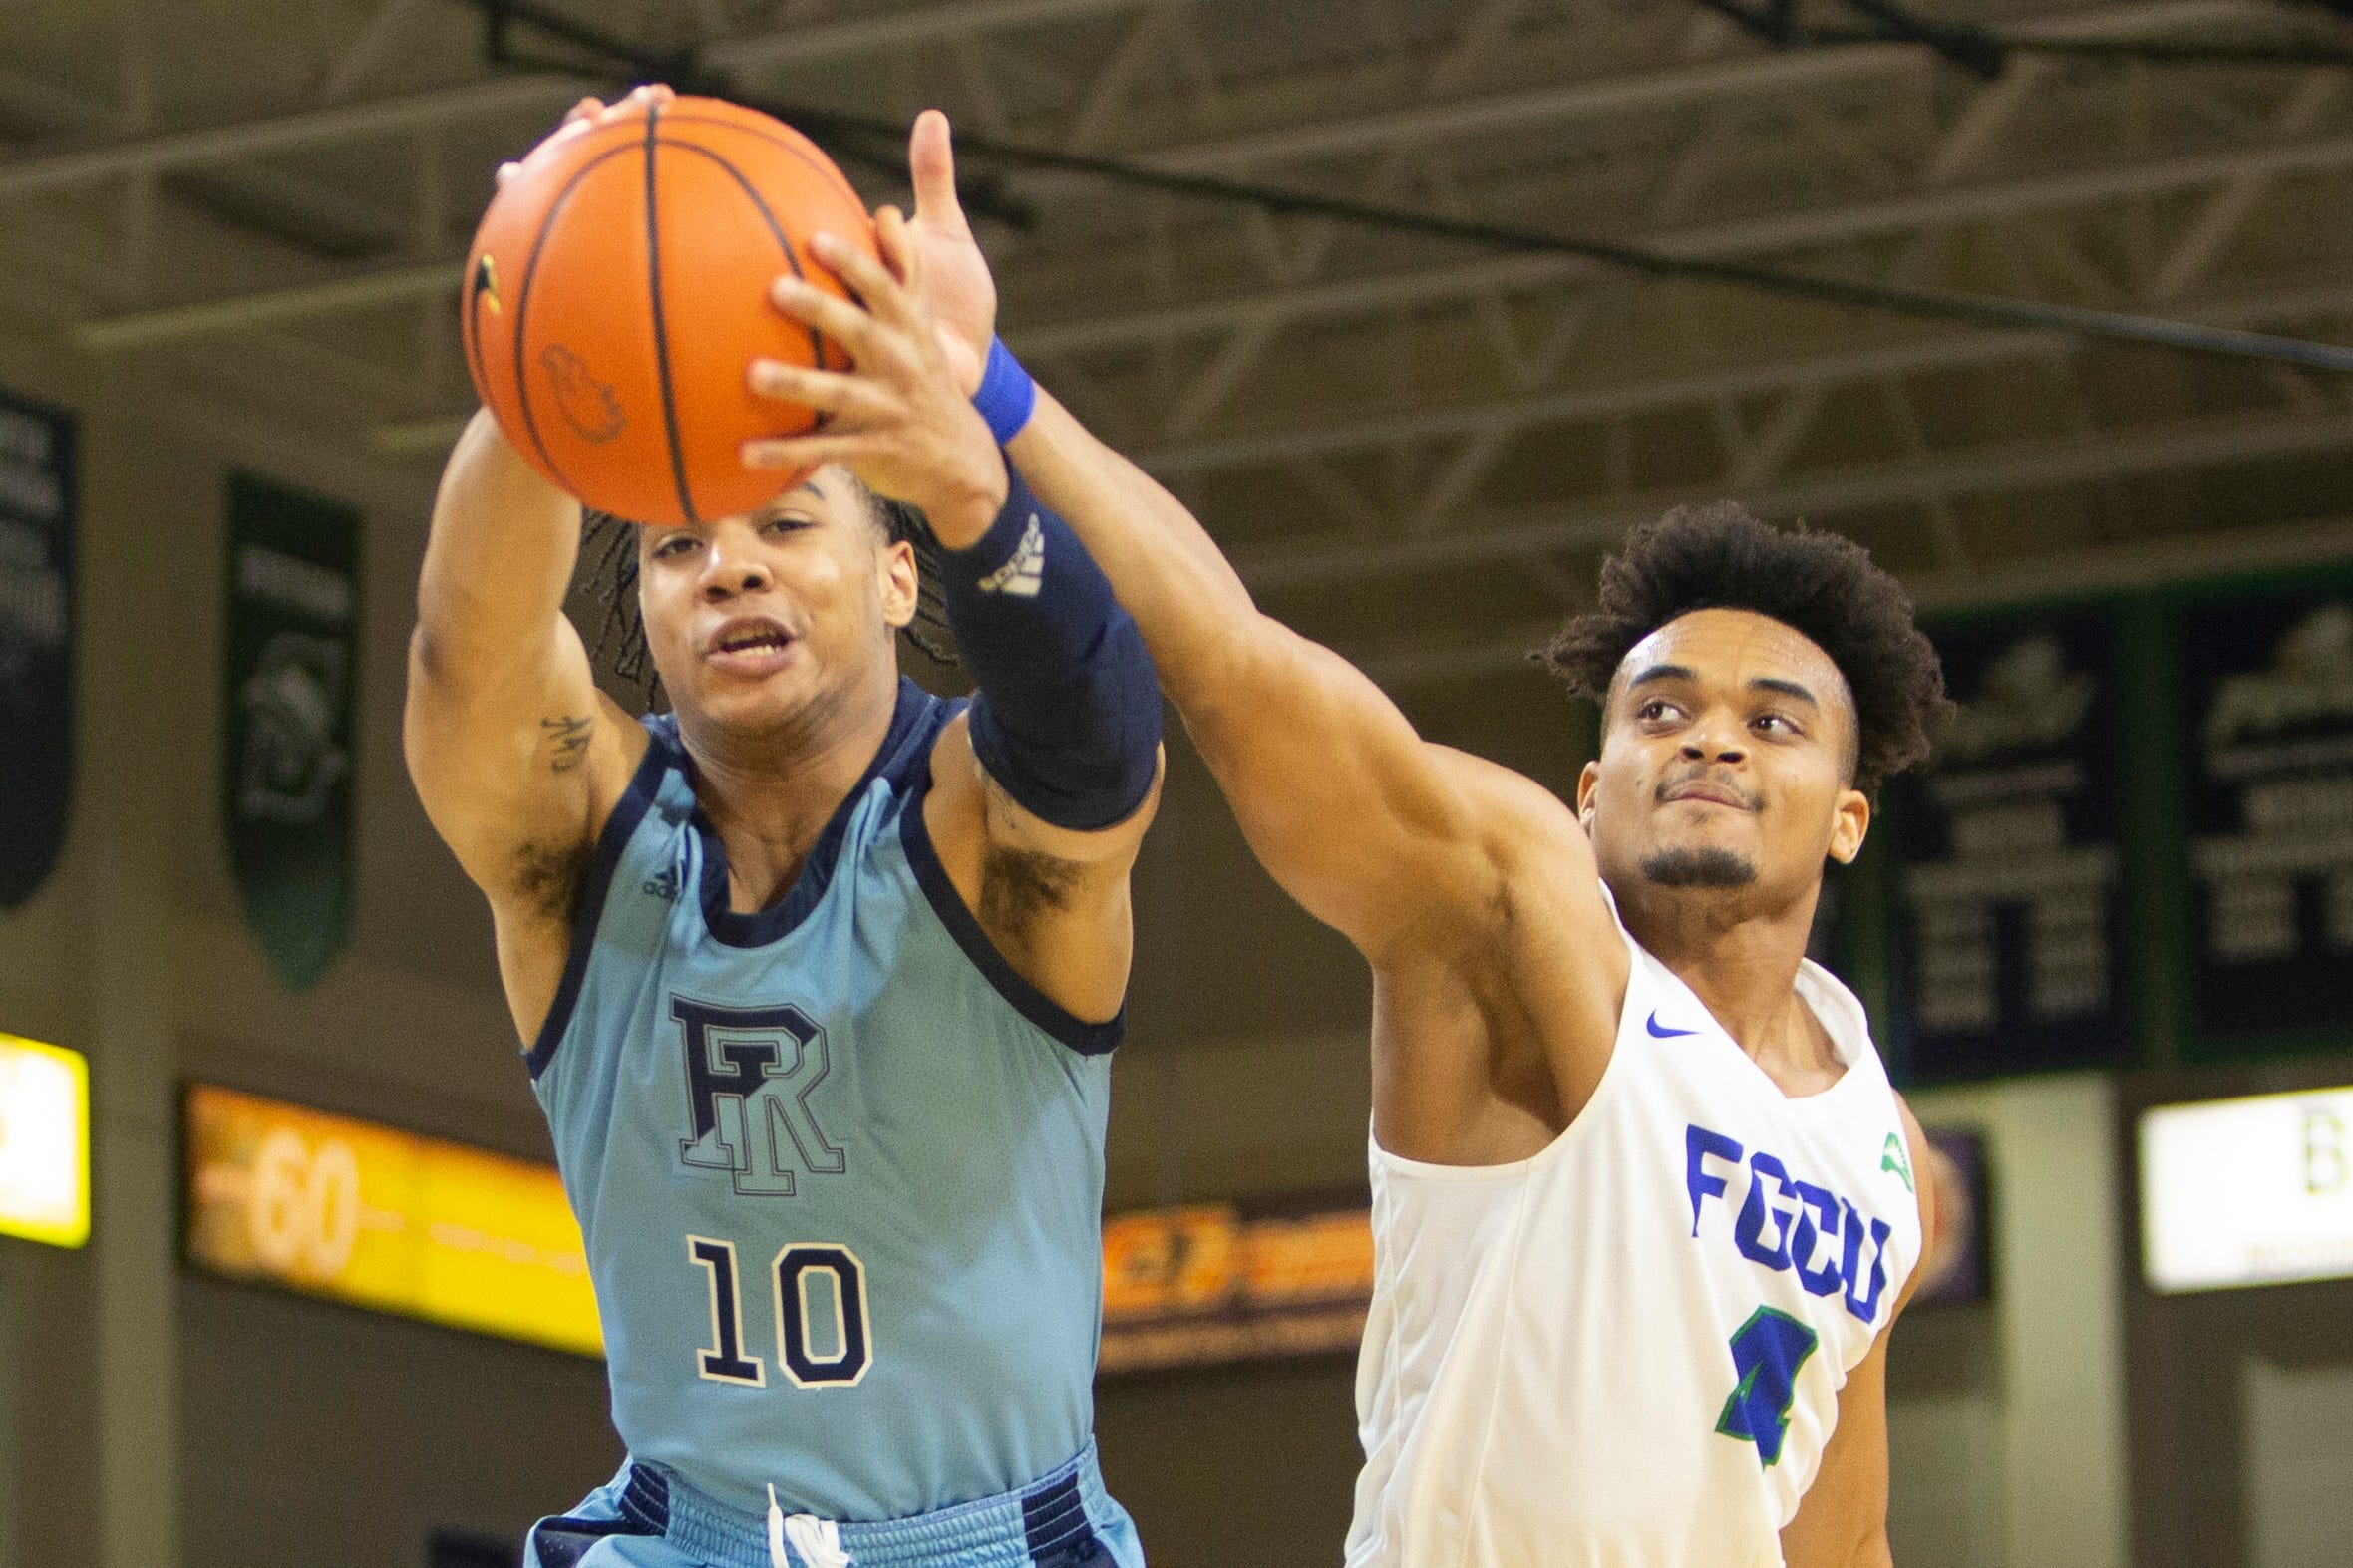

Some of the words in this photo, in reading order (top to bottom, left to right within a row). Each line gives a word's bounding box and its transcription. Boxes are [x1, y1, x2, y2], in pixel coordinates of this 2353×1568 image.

[251, 1126, 361, 1280] 60
[1686, 1123, 1891, 1325] FGCU
[686, 1234, 873, 1390] 10
[1714, 1304, 1820, 1470] 4
